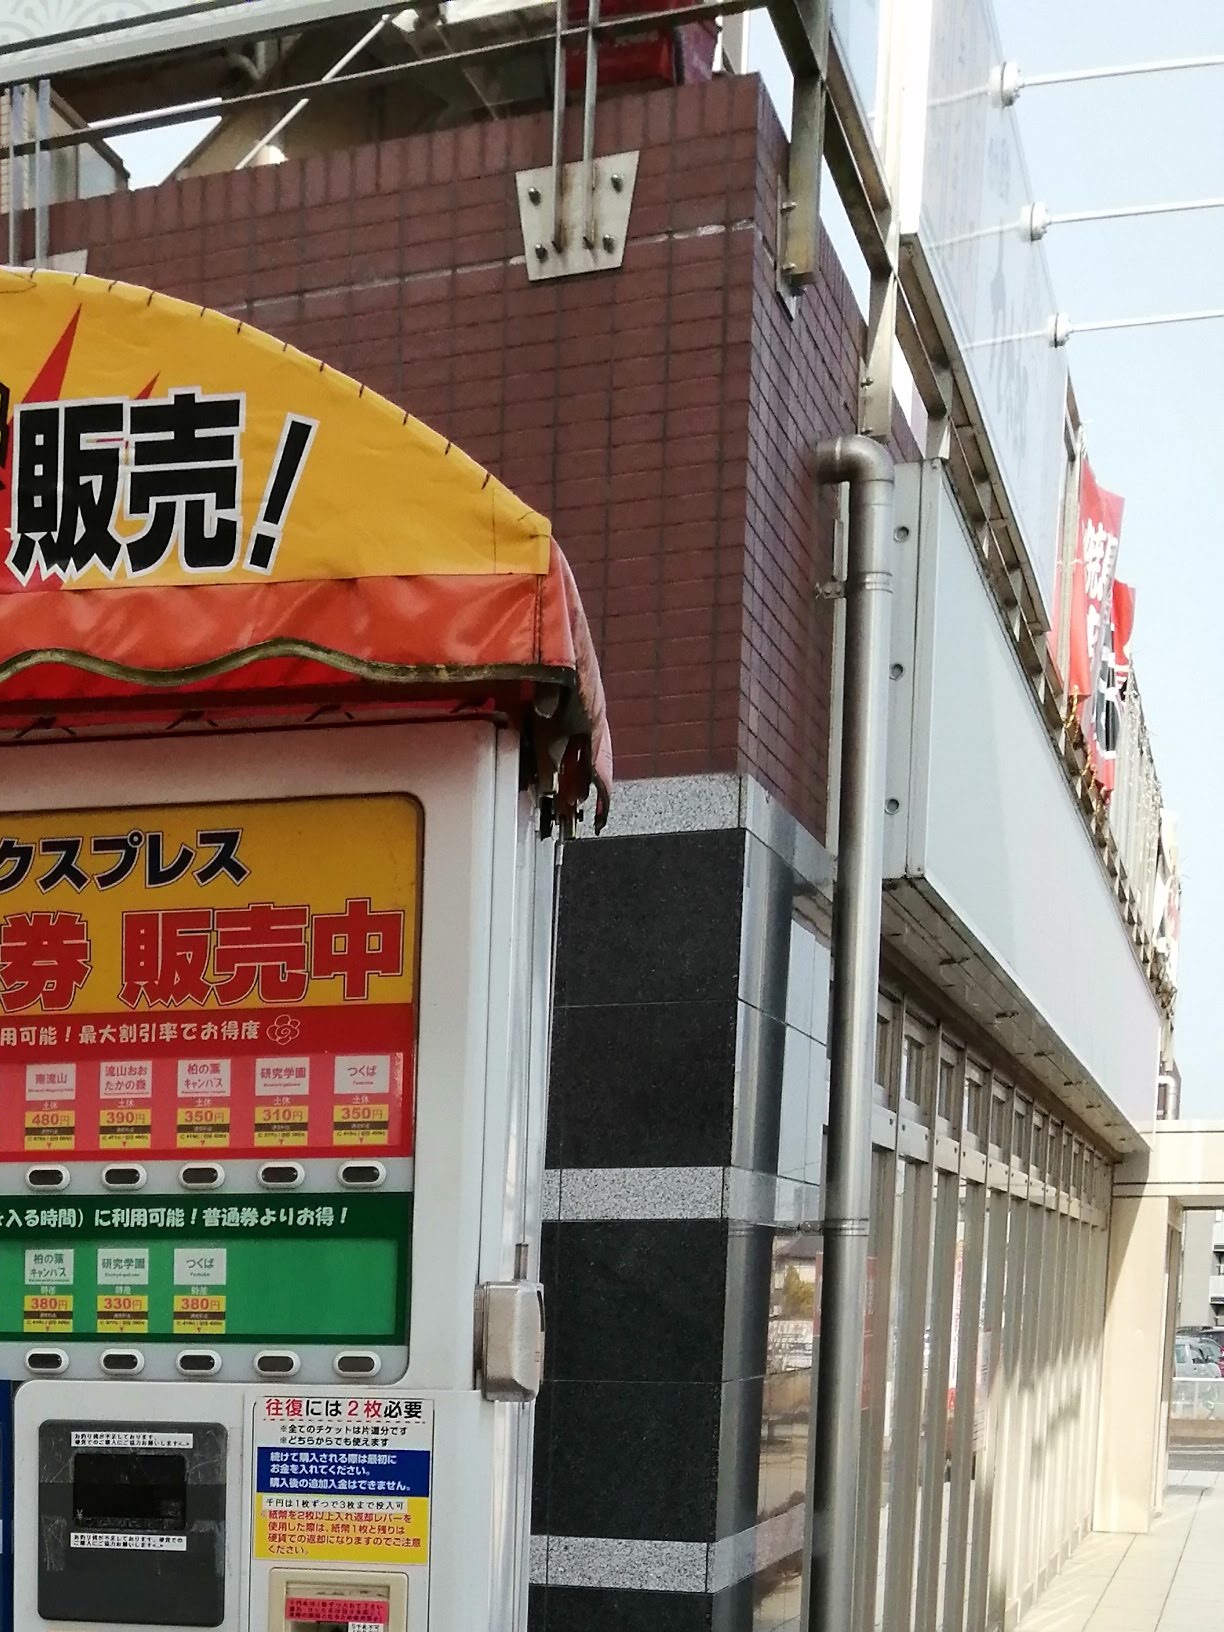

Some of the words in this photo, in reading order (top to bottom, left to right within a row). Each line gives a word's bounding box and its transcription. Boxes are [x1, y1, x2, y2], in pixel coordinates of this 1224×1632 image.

[120, 898, 406, 1008] 販売中
[105, 1066, 148, 1078] 流山おお
[260, 1067, 306, 1079] 研究学園
[347, 1065, 378, 1077] つくば
[31, 1113, 70, 1126] 480円
[106, 1111, 146, 1125] 390円
[184, 1109, 225, 1124] 350円
[262, 1108, 303, 1122] 310円
[341, 1106, 383, 1121] 350円
[101, 1258, 146, 1270] 研究学園
[186, 1257, 215, 1269] つくば
[31, 1297, 68, 1310] 380円
[103, 1297, 142, 1310] 330円
[181, 1297, 220, 1310] 380円
